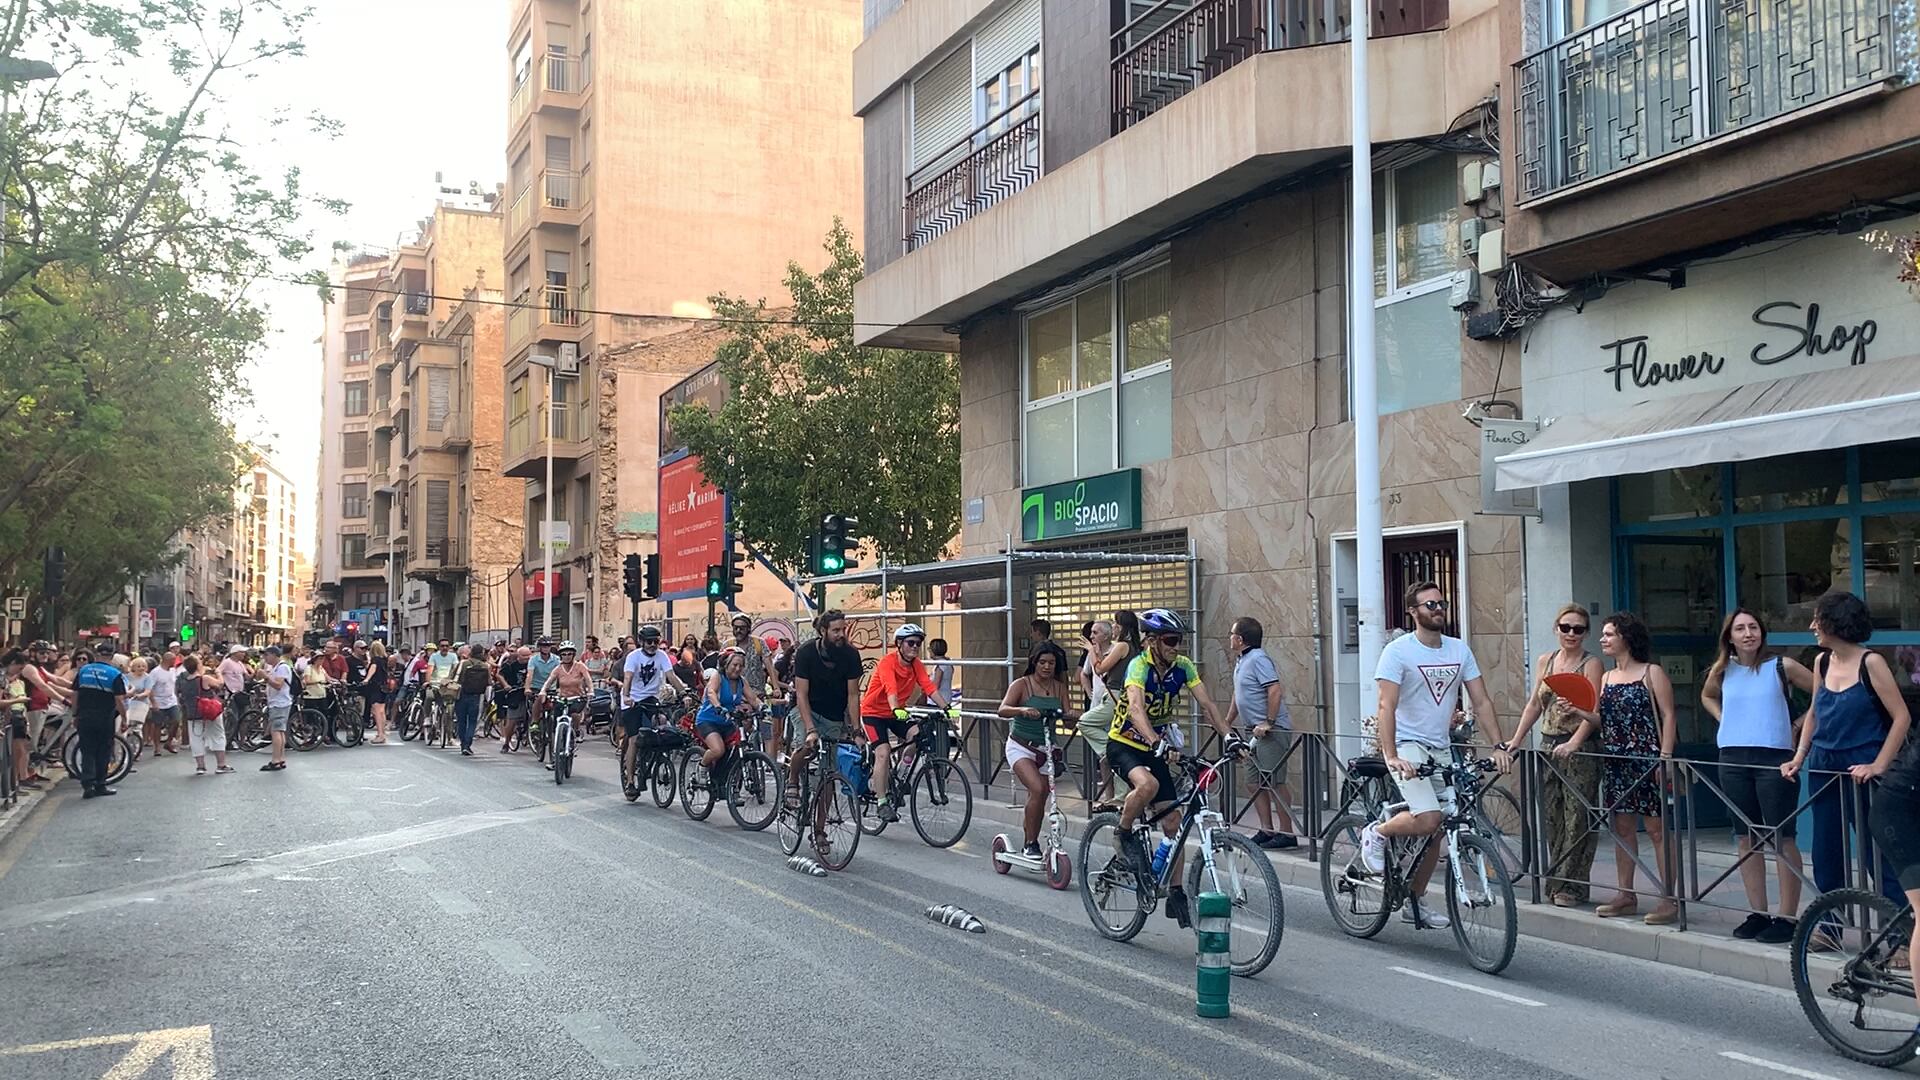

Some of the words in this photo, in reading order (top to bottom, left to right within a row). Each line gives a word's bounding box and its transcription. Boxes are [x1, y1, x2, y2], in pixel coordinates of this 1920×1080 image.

[1600, 335, 1725, 392] Flower
[1750, 301, 1878, 366] Shop
[1075, 502, 1118, 525] SPACIO
[1425, 667, 1457, 678] GUESS
